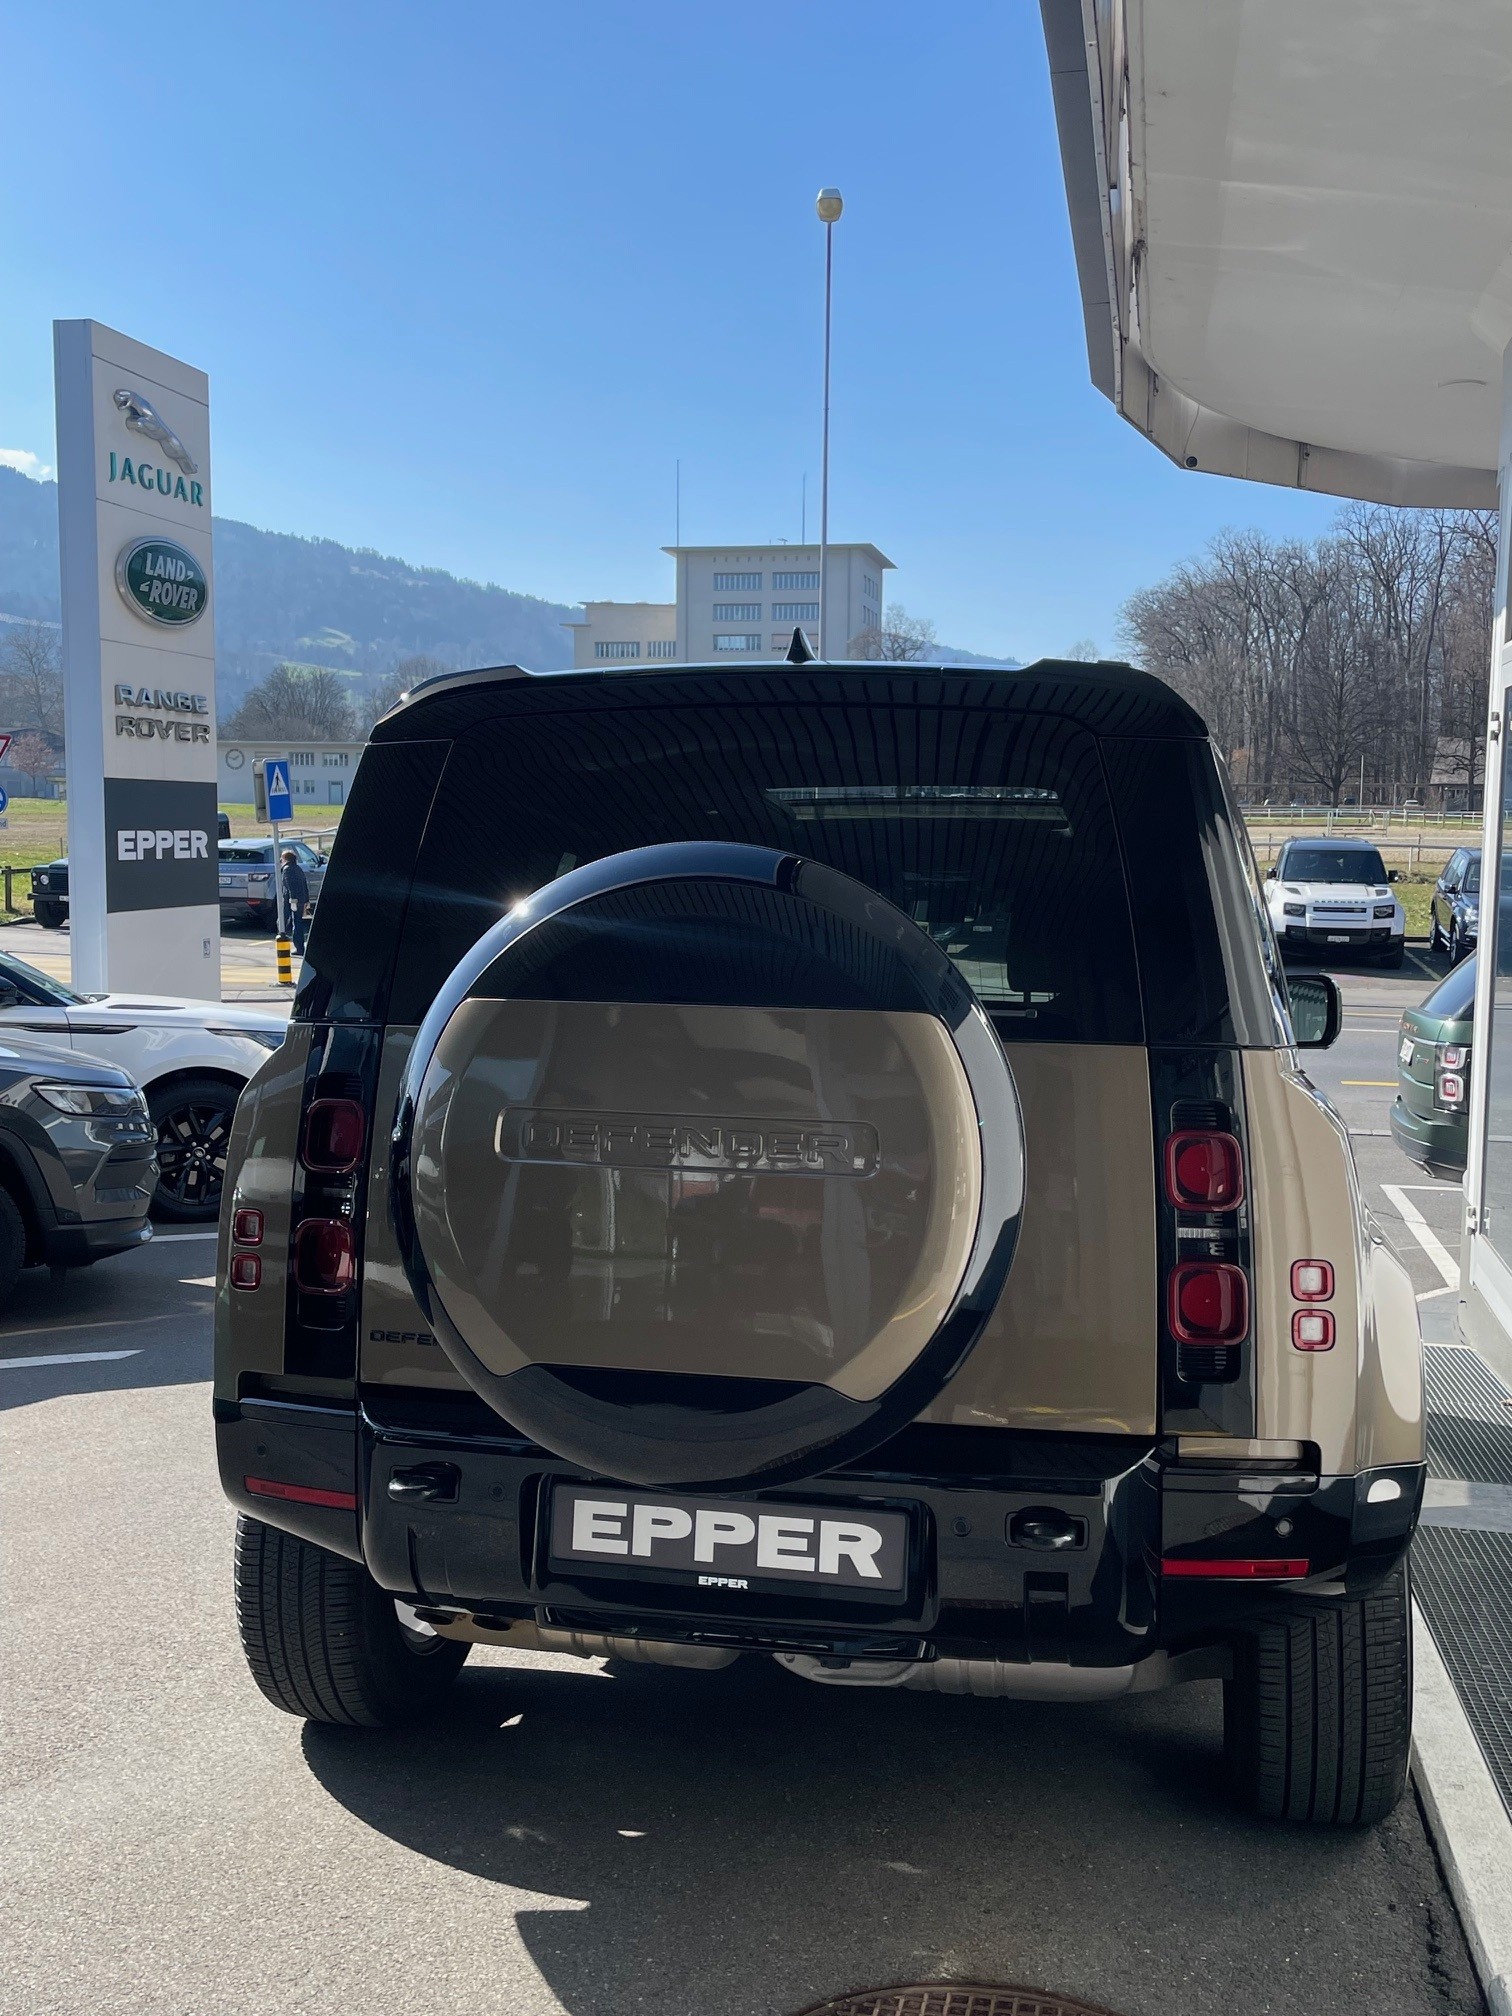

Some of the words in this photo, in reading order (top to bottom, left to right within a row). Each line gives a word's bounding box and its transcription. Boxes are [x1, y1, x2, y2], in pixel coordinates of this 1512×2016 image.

[109, 452, 203, 506] JAGUAR
[145, 553, 186, 582] LAND
[149, 580, 198, 610] ROVER
[115, 685, 208, 714] RANGE
[116, 716, 210, 743] ROVER
[117, 830, 209, 861] EPPER
[524, 1120, 849, 1165] DEFENDER
[369, 1329, 438, 1346] DEFE
[572, 1500, 882, 1578] EPPER
[698, 1576, 748, 1589] EPPER
